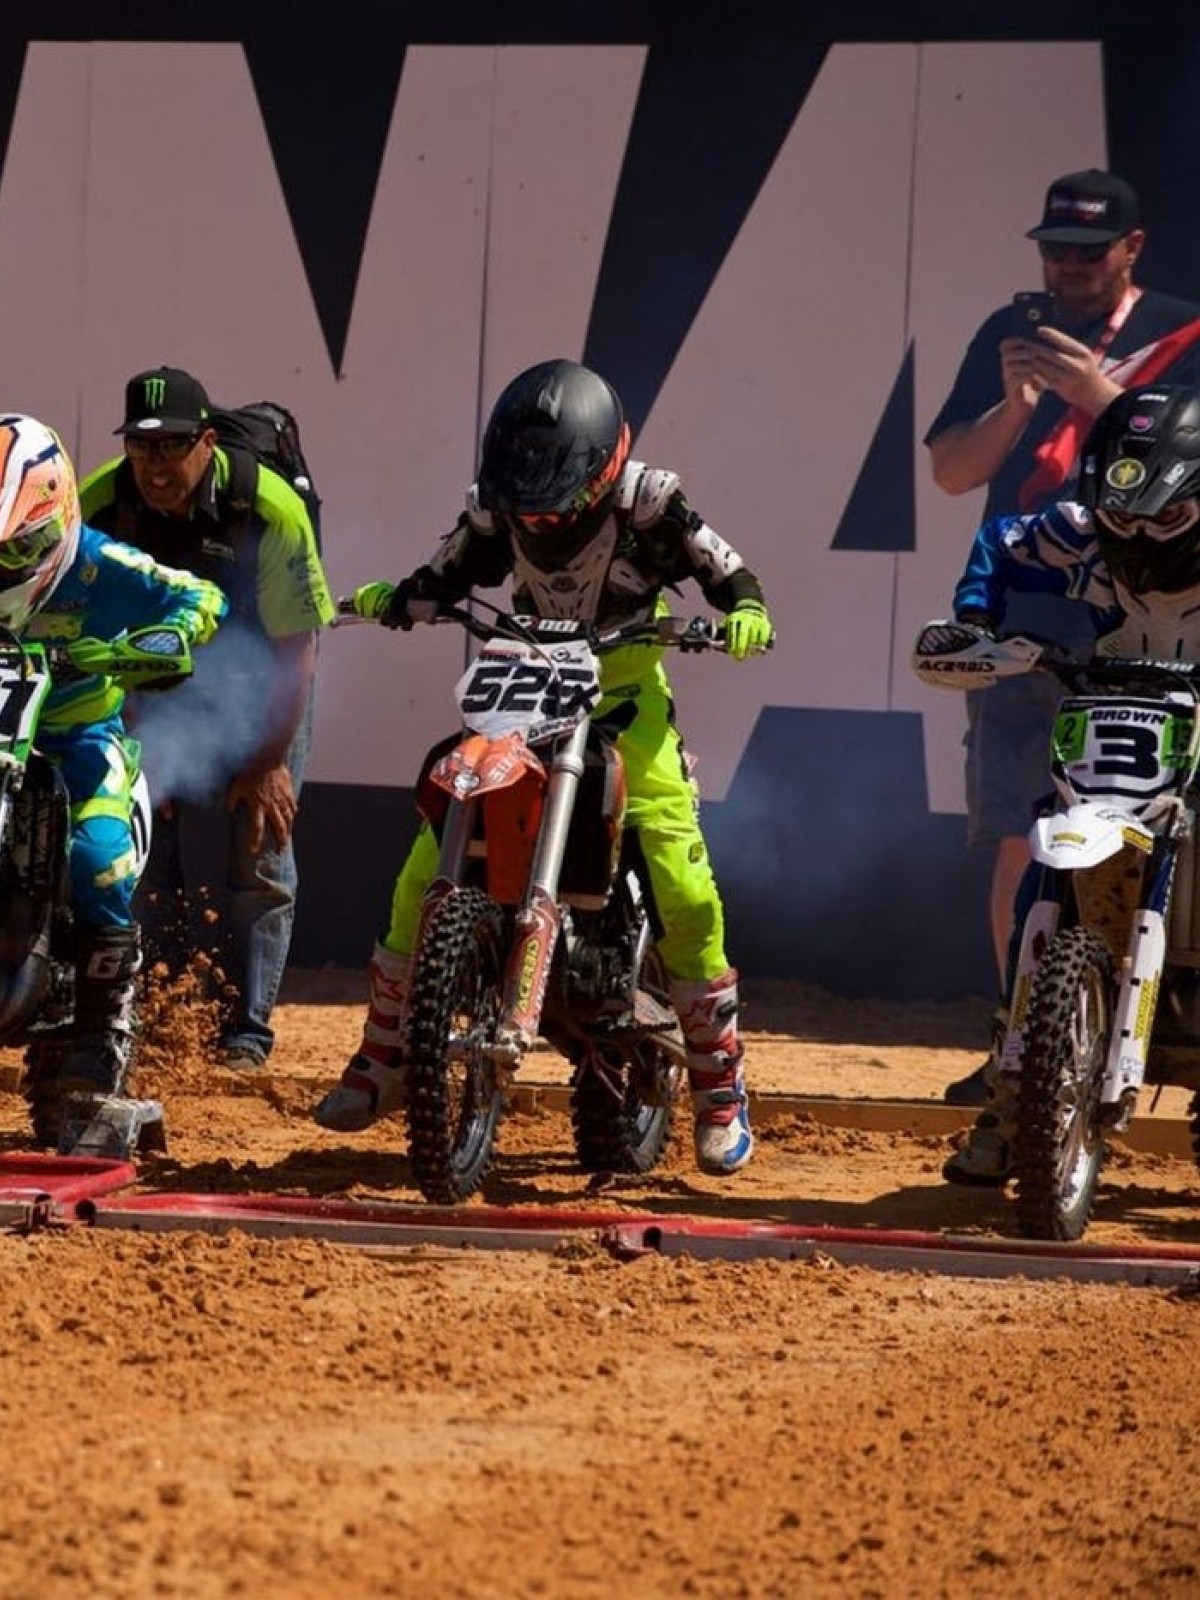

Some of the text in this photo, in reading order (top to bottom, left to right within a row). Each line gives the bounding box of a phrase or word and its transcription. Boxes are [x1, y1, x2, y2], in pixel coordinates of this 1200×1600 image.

[917, 660, 996, 673] ACERBIS
[1090, 709, 1166, 724] BROWN
[1093, 724, 1159, 780] 3
